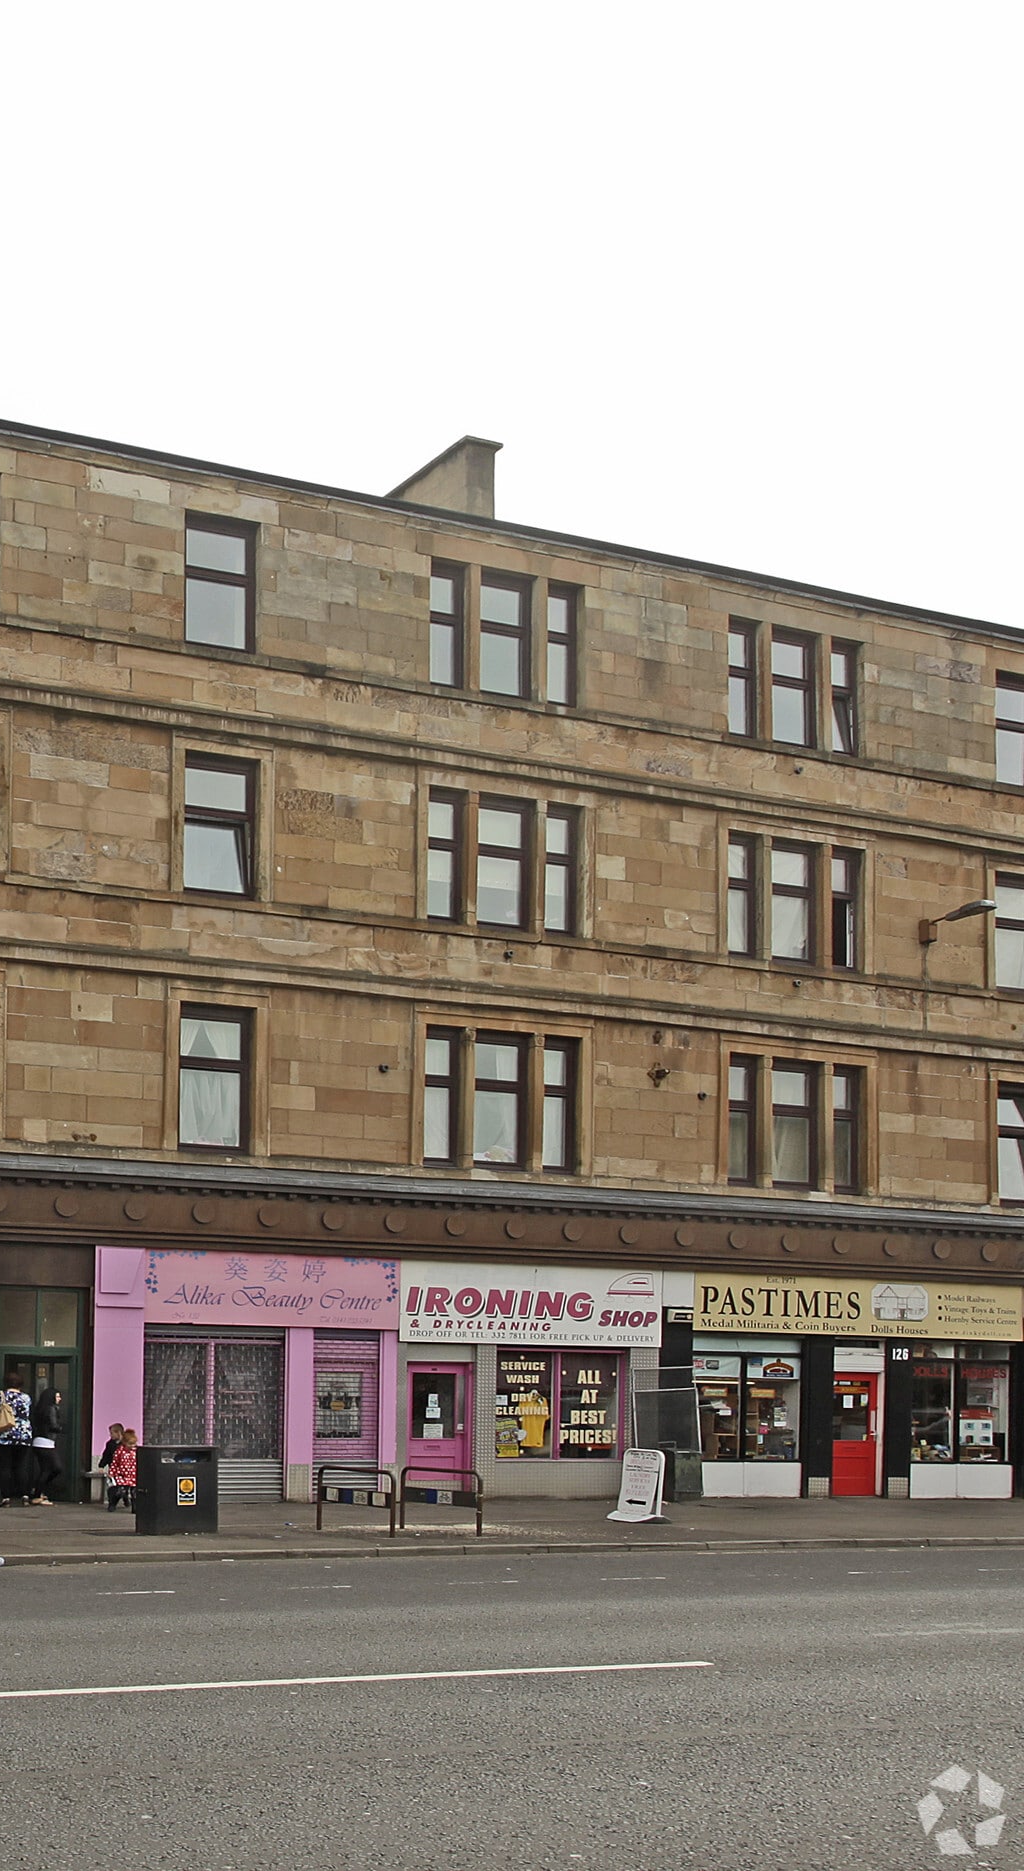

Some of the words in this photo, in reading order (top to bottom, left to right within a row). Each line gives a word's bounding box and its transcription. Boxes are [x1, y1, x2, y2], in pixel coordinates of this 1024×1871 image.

[781, 1276, 797, 1284] 1971
[163, 1283, 226, 1306] Alika
[231, 1285, 314, 1315] Beauty
[319, 1288, 383, 1311] Centre
[700, 1286, 861, 1320] PASTIMES
[944, 1294, 965, 1302] Model
[966, 1295, 996, 1304] Railways
[406, 1286, 594, 1322] IRONING
[598, 1310, 658, 1328] SHOP
[944, 1305, 969, 1313] Vintage
[971, 1306, 987, 1315] Toys
[996, 1307, 1017, 1315] Trains
[410, 1319, 420, 1328] &
[433, 1320, 552, 1331] DRYCLEANING
[700, 1318, 734, 1328] Medal
[736, 1319, 779, 1330] Militaria
[782, 1321, 792, 1330] &
[795, 1321, 820, 1331] Coin
[822, 1323, 856, 1333] Buyers
[944, 1315, 969, 1325] Hornby
[971, 1317, 995, 1325] Service
[996, 1317, 1018, 1325] Centre
[871, 1324, 894, 1334] Dolls
[896, 1325, 929, 1335] Houses
[892, 1348, 909, 1360] 126
[500, 1361, 546, 1371] SERVICE
[506, 1375, 540, 1384] WASH
[577, 1370, 602, 1384] ALL
[511, 1393, 533, 1402] DRY
[580, 1389, 599, 1404] AT
[495, 1406, 549, 1416] CLEANING
[570, 1410, 607, 1425] BEST
[559, 1429, 617, 1444] PRICES!
